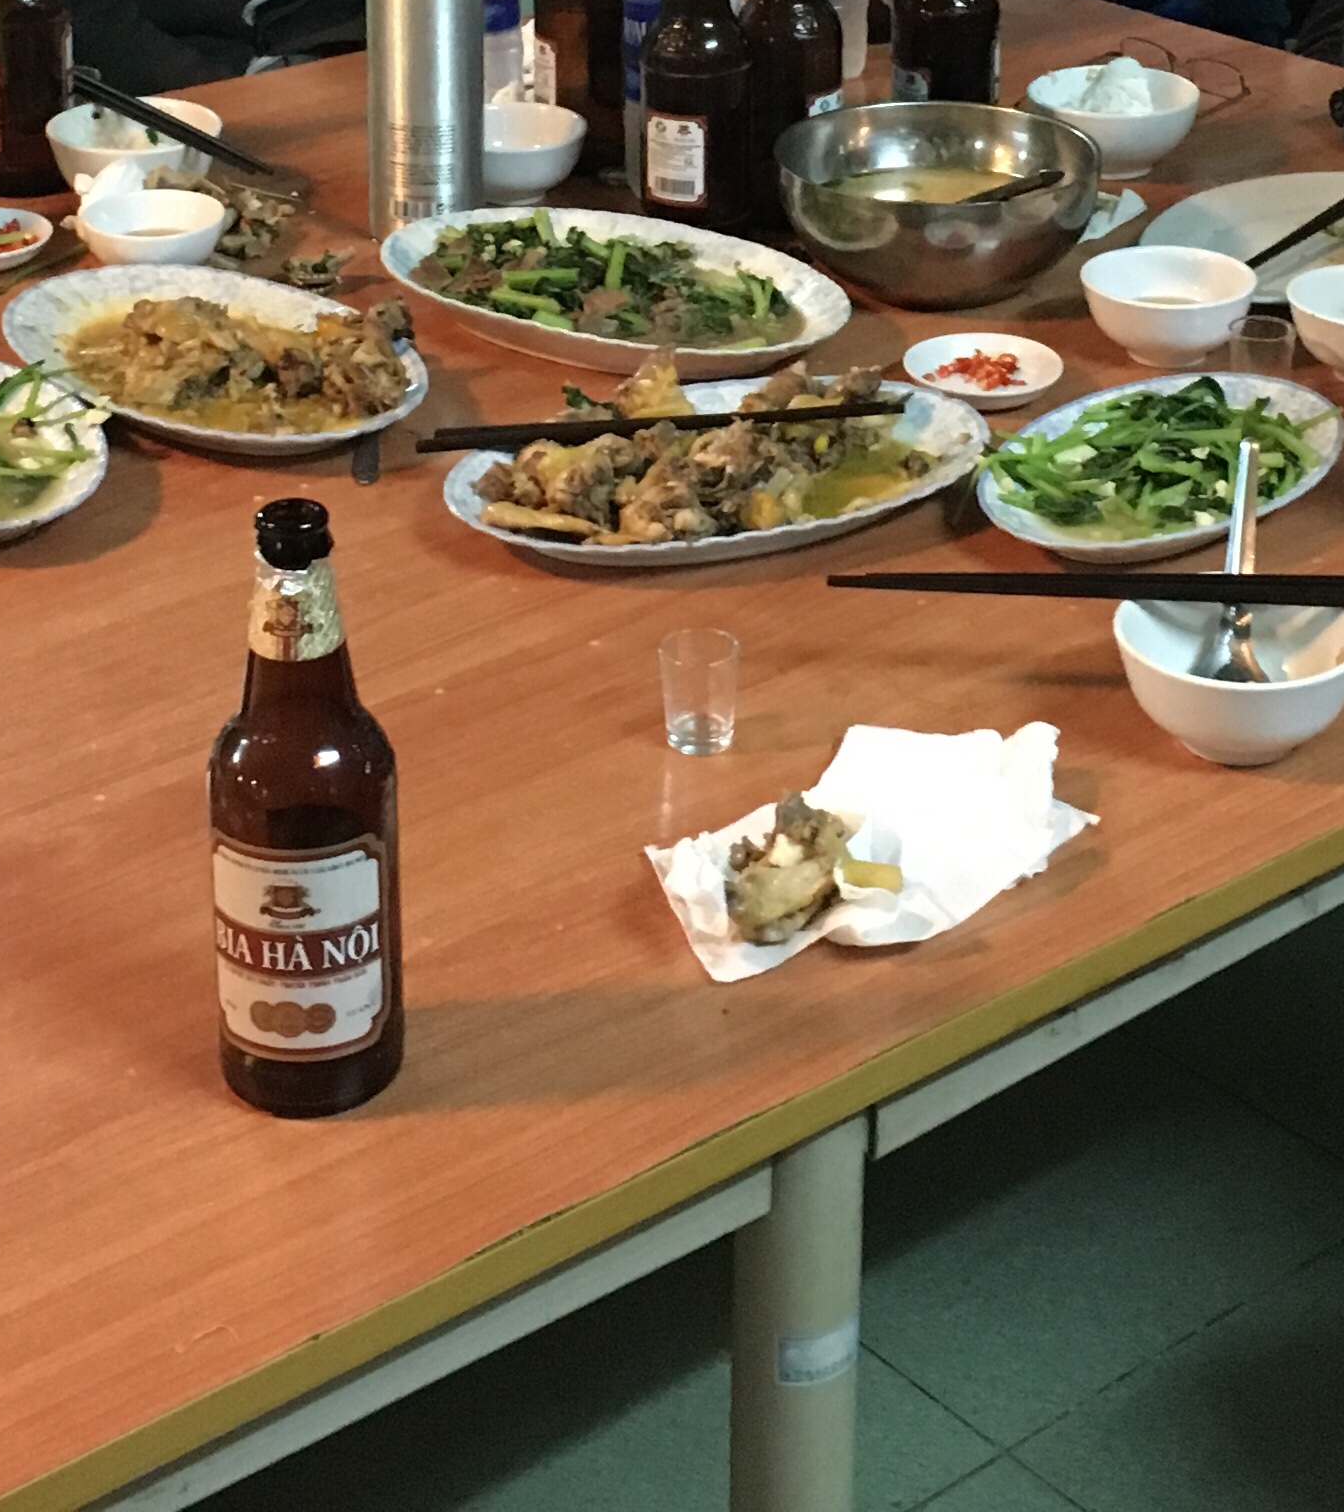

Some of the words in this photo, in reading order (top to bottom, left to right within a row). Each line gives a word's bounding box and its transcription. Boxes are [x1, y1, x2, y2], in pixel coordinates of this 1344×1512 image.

[216, 918, 254, 965] BIA
[262, 935, 313, 971] HÀ
[321, 921, 379, 970] NỘI
